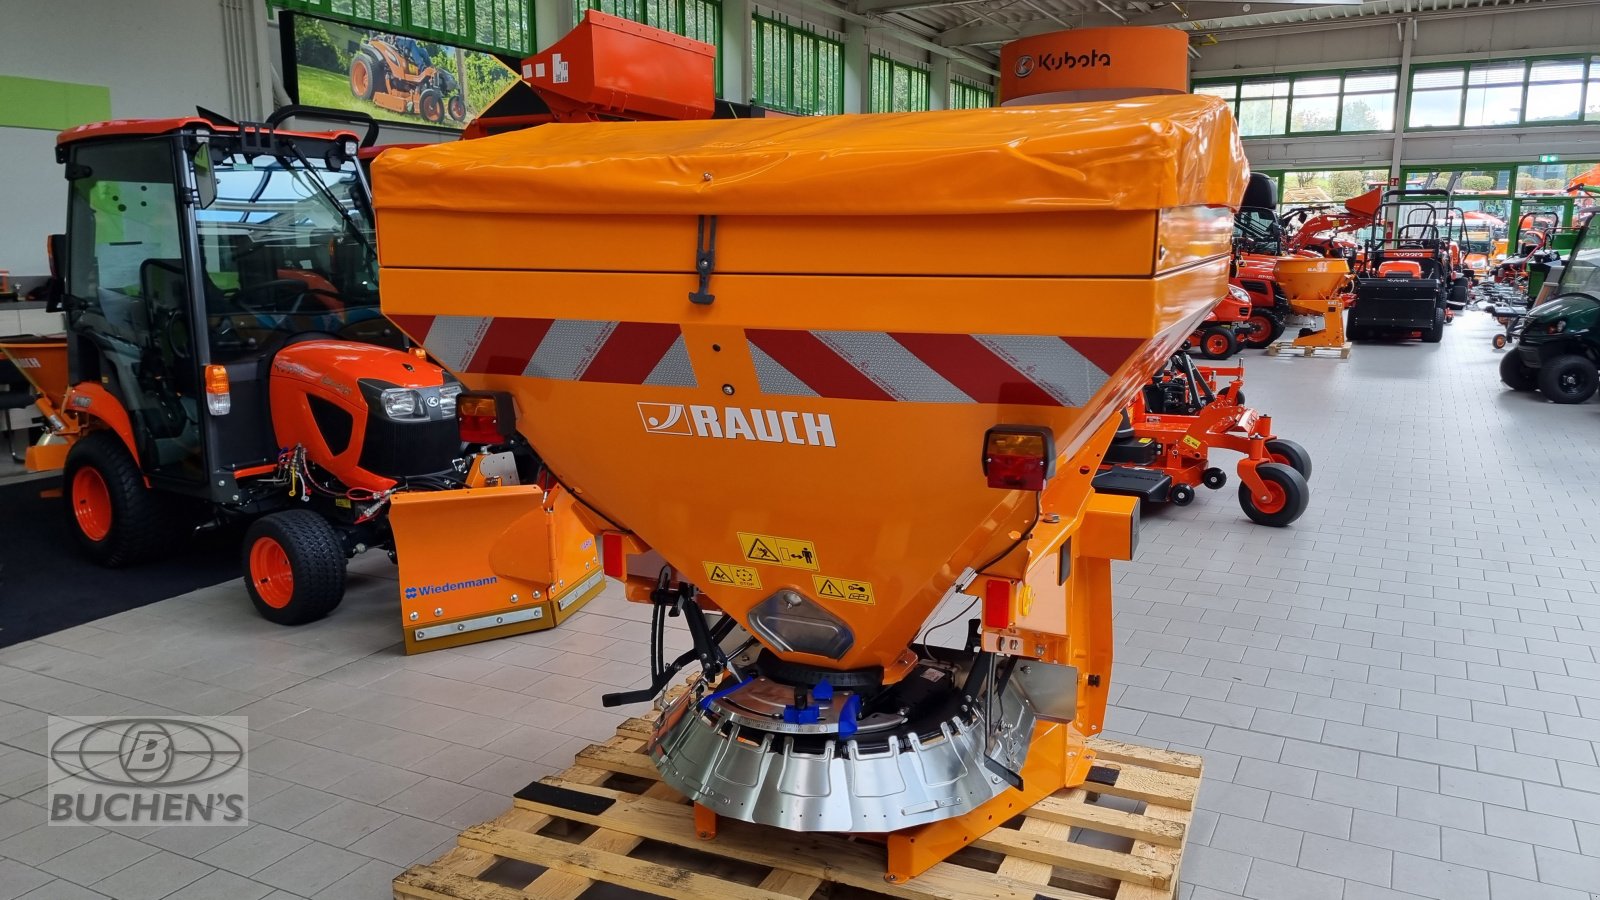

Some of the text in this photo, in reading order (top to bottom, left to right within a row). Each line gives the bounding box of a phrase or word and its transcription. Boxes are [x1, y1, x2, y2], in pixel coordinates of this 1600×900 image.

[1038, 49, 1111, 71] Kubota
[690, 404, 837, 447] RAUCH
[418, 576, 498, 596] Wiedenmann
